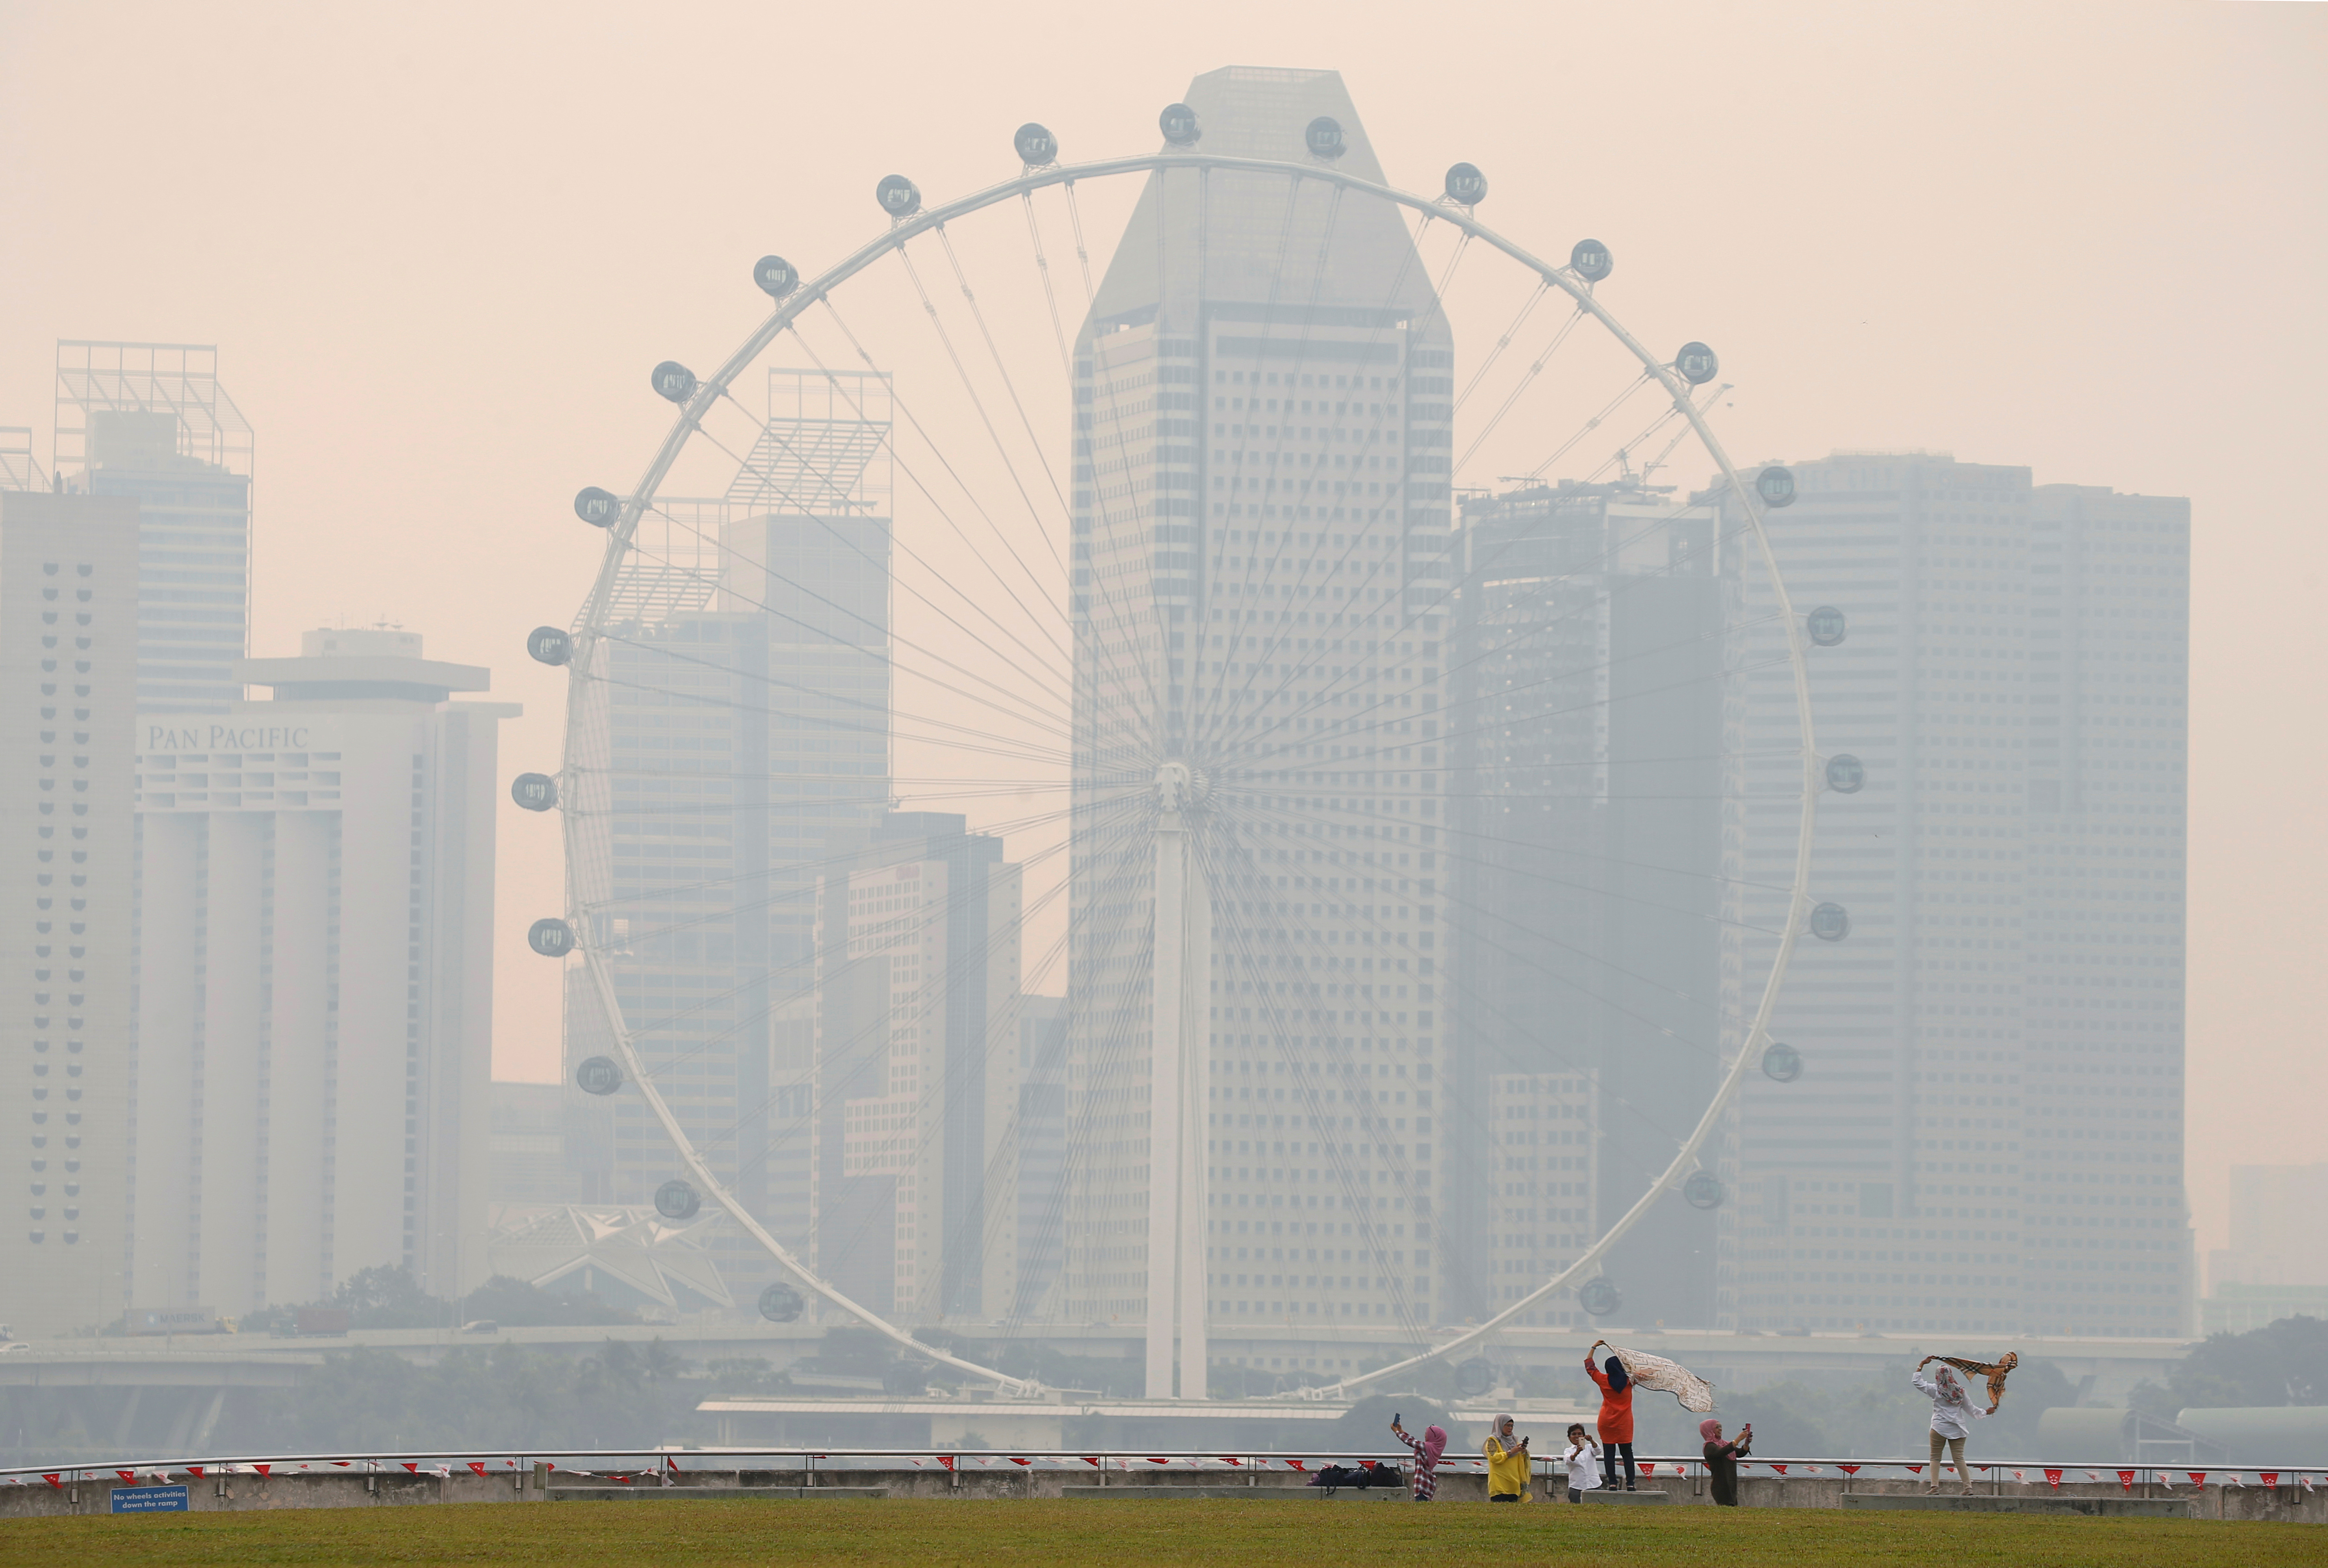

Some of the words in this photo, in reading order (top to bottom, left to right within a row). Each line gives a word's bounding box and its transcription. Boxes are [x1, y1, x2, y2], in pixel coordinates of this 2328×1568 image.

[149, 726, 198, 749] PAN
[209, 725, 309, 749] PACIFIC
[160, 1313, 205, 1324] MAERSK
